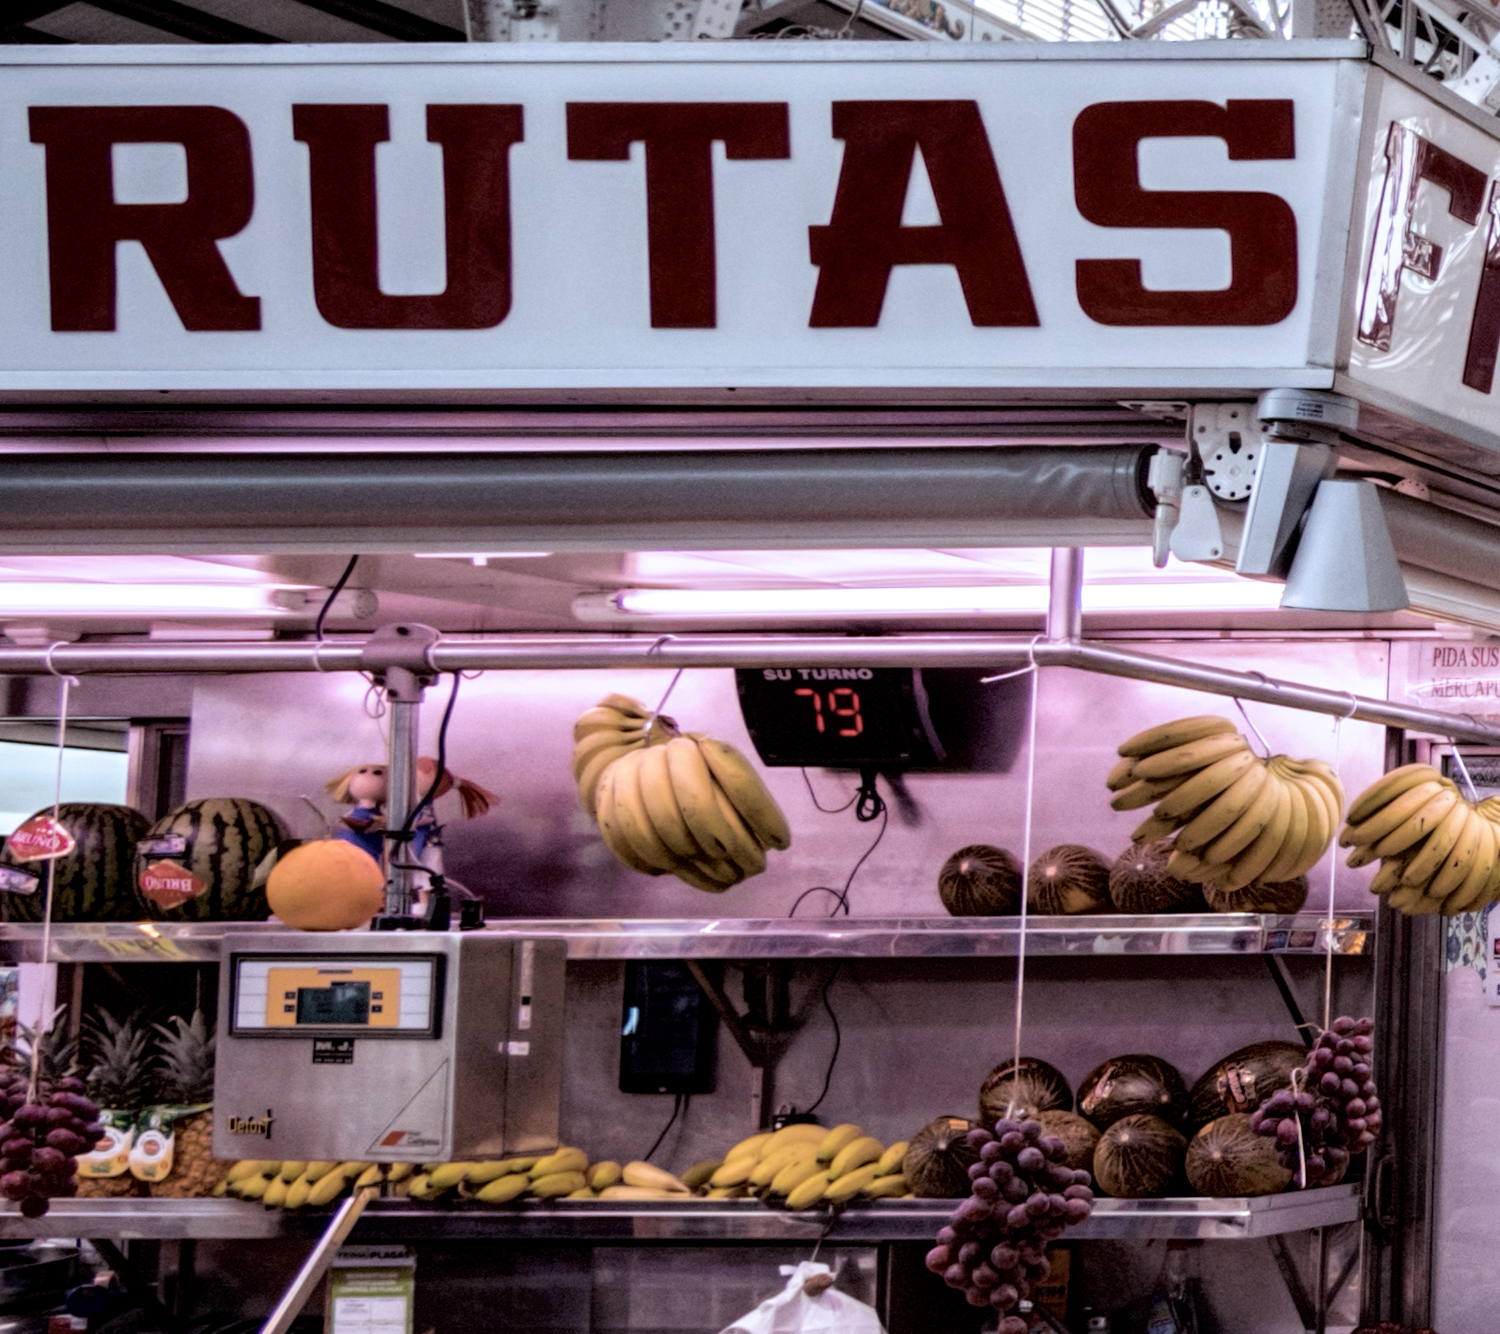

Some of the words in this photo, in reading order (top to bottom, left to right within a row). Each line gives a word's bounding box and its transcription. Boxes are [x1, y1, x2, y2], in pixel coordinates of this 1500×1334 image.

[26, 98, 1299, 334] RUTAS
[1432, 646, 1469, 667] PIDA
[1471, 646, 1500, 667] SUS
[763, 668, 792, 681] SU
[797, 668, 873, 681] TURNO
[794, 687, 864, 737] 79
